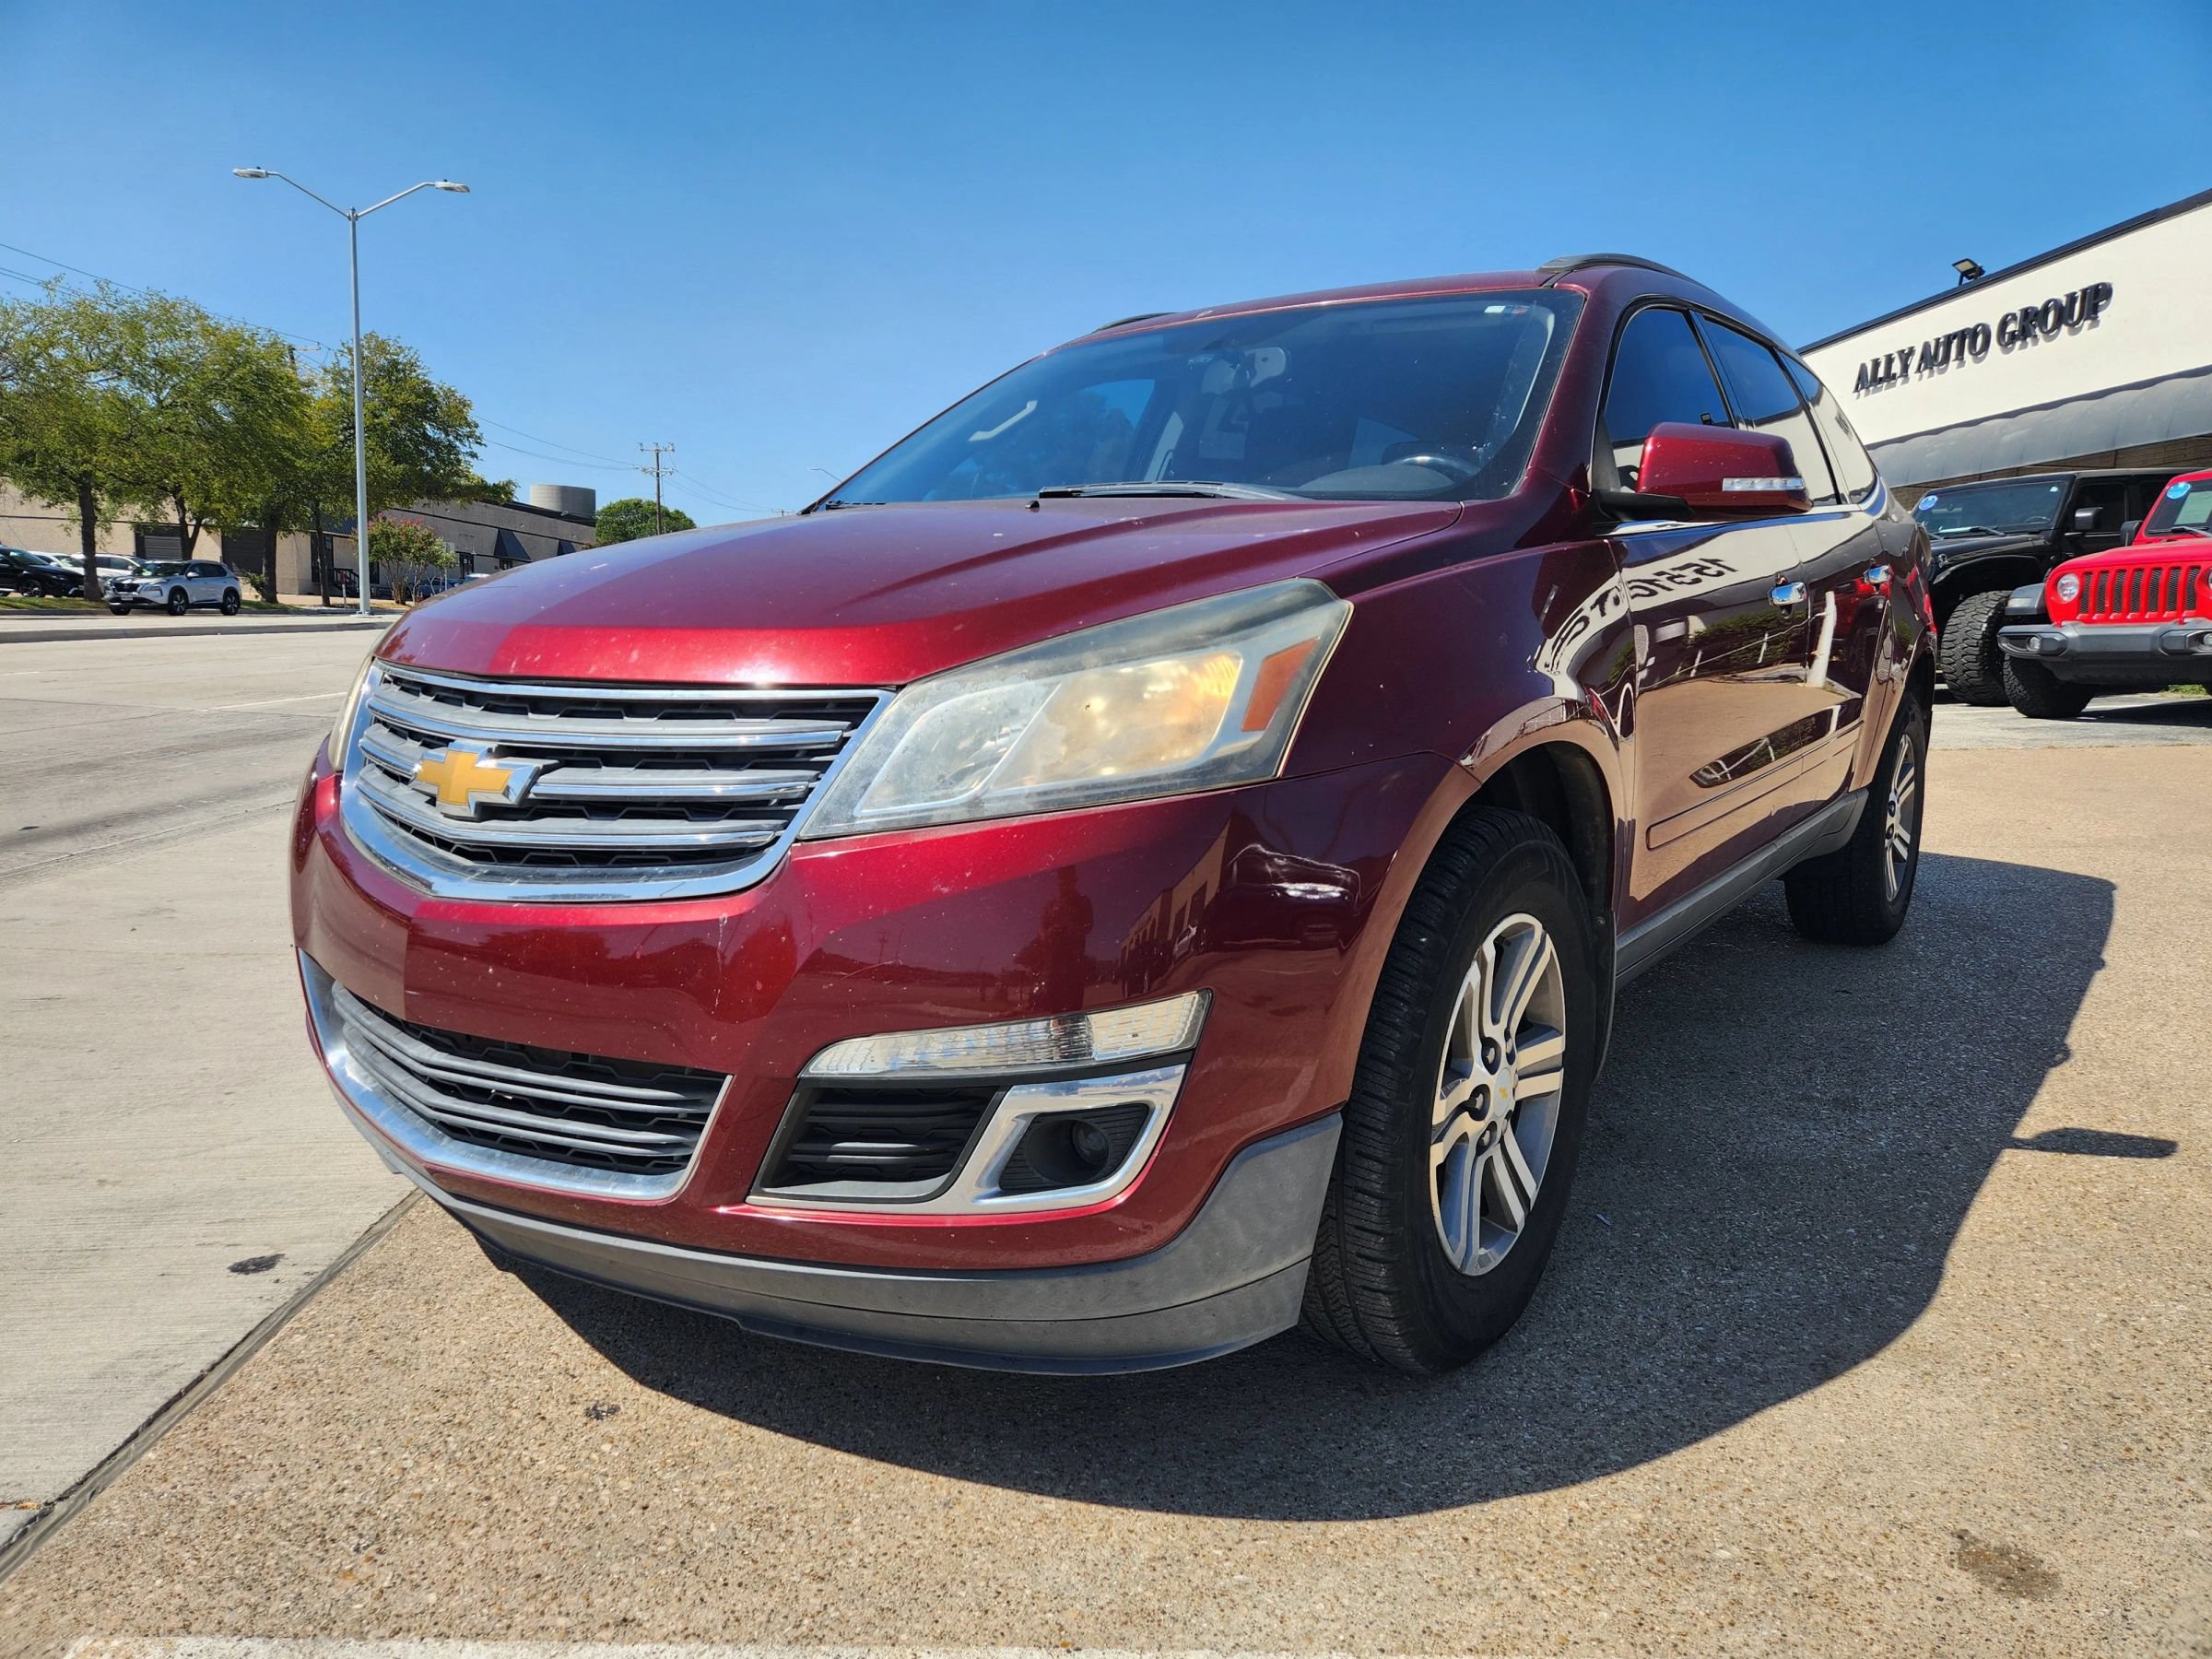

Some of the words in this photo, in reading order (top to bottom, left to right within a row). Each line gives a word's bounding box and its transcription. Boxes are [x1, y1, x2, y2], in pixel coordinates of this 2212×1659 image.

[1853, 346, 1916, 394] ALLY
[1914, 323, 1992, 374] AUTO
[1996, 282, 2113, 347] GROUP
